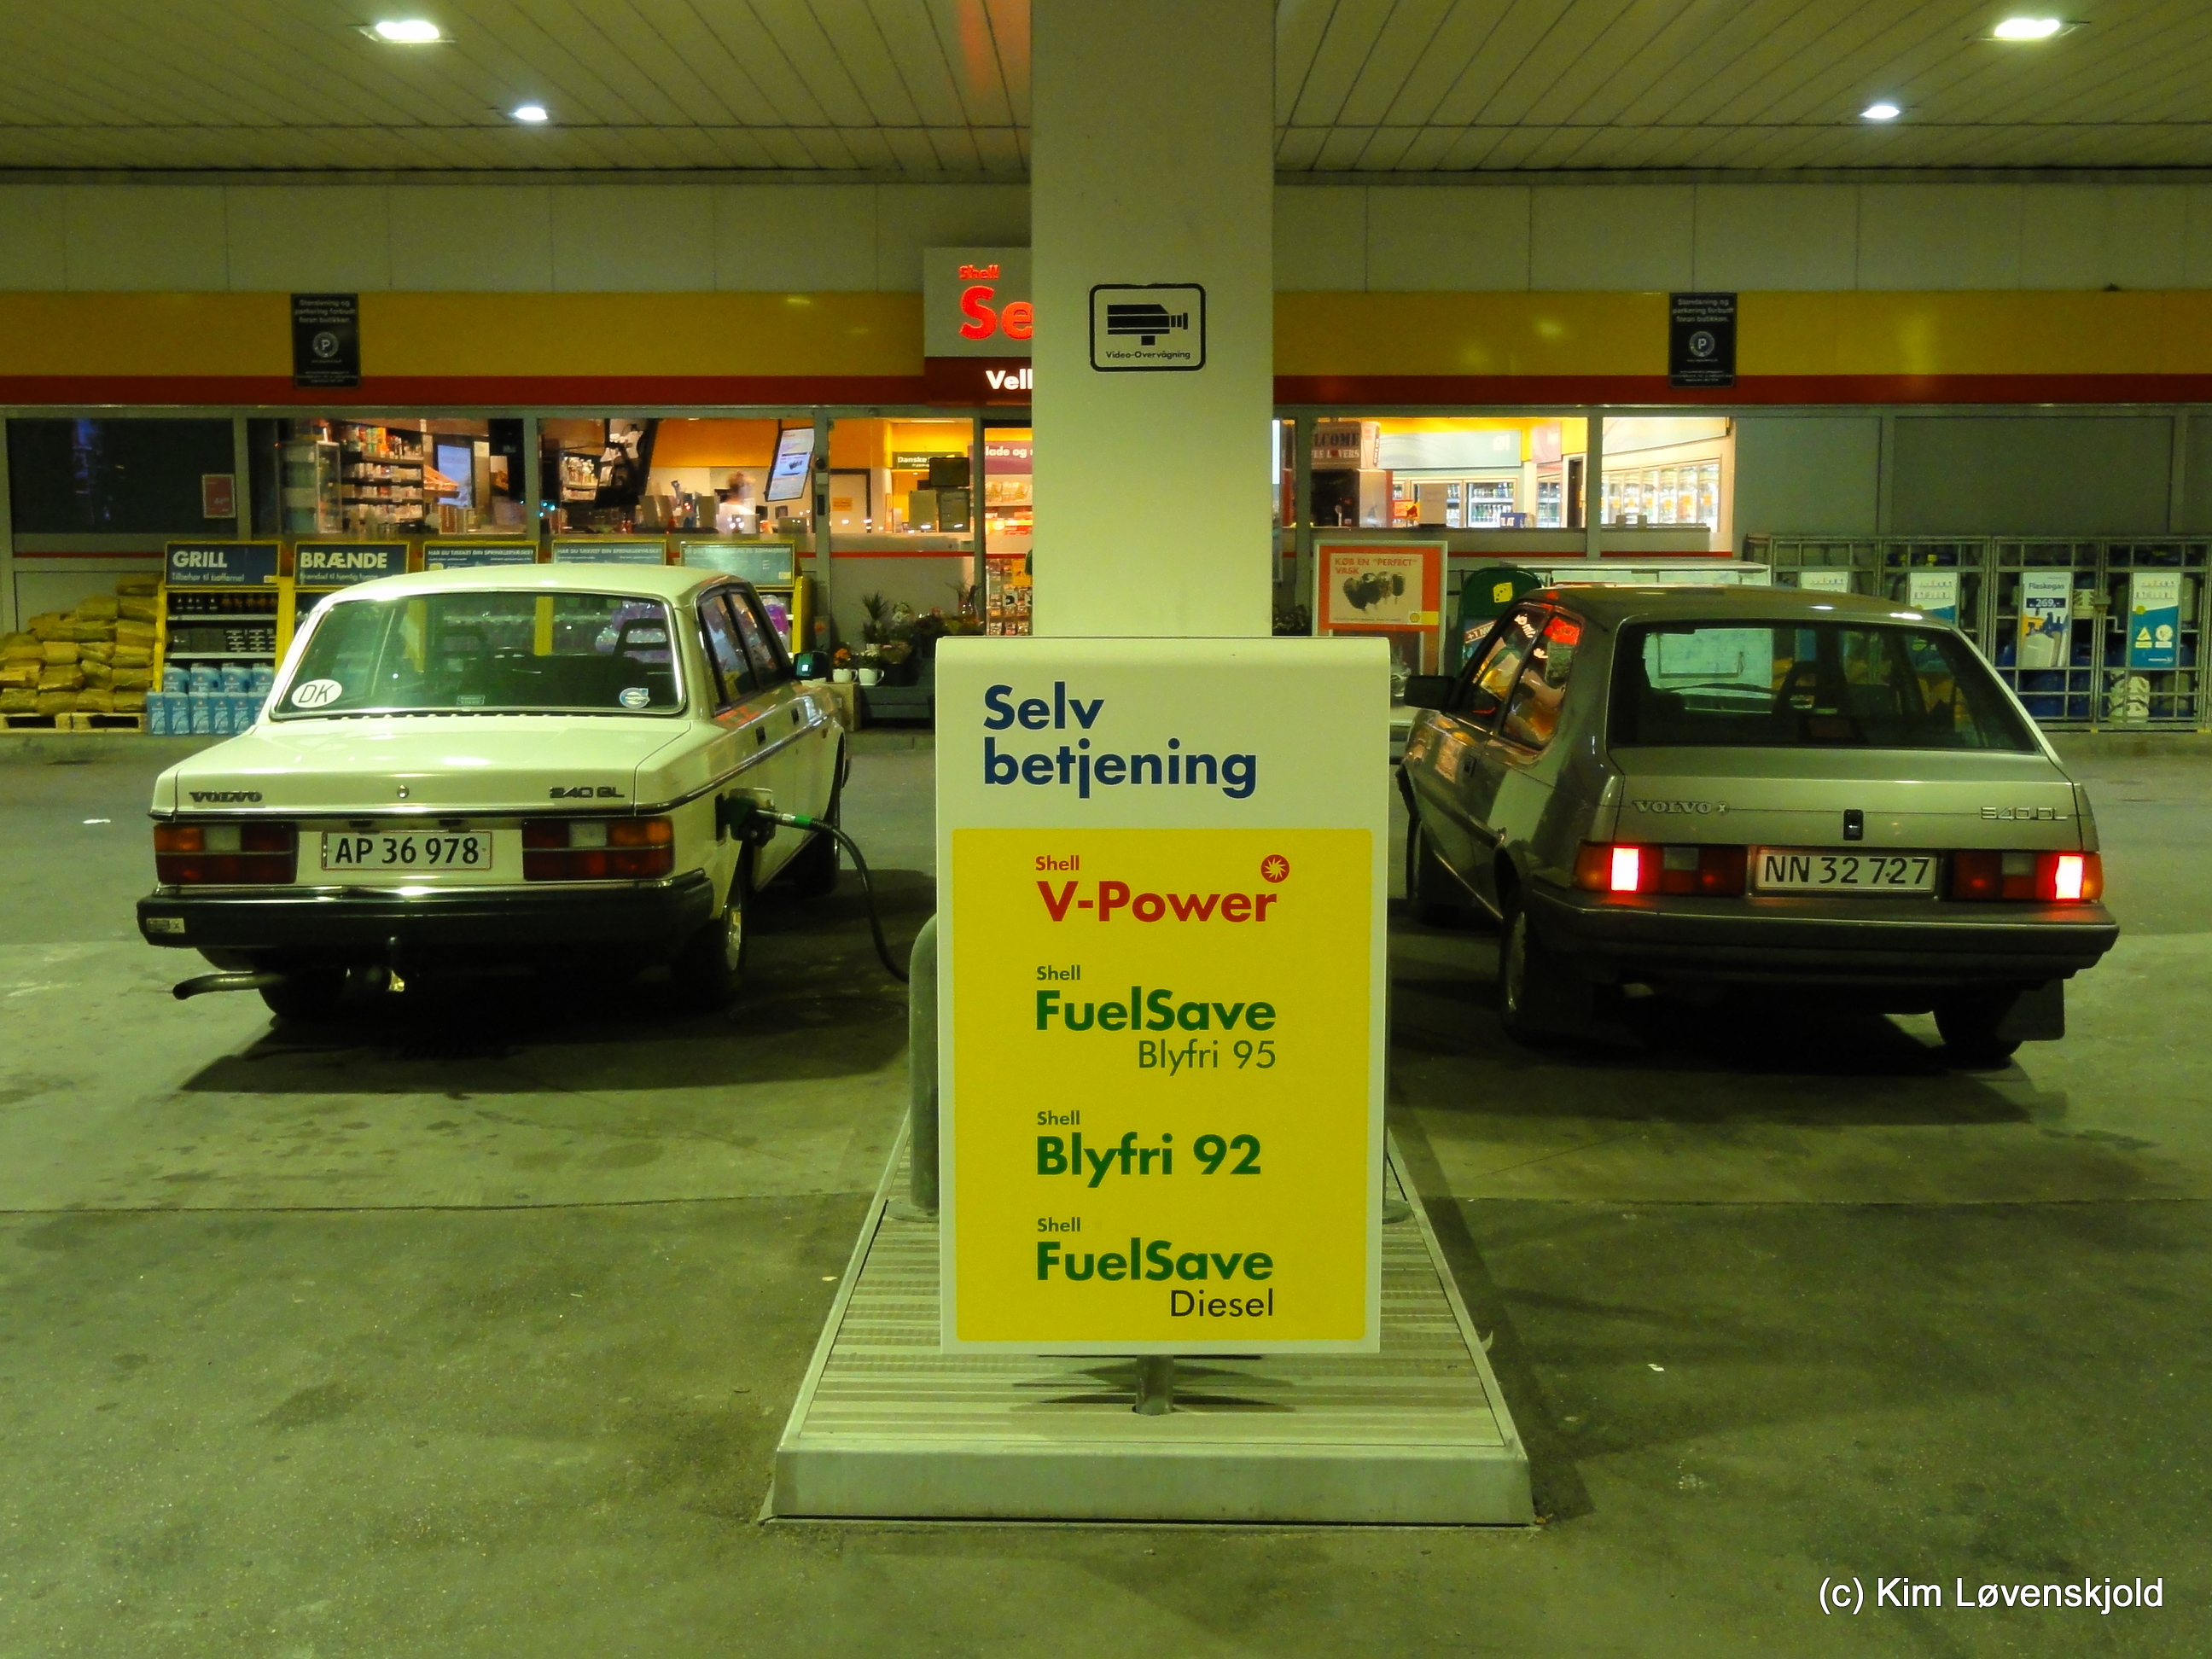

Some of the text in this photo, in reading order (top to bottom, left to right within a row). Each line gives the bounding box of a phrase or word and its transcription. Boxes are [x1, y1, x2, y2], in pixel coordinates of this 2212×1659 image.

[958, 265, 999, 279] Shell
[959, 285, 1033, 340] Se
[1106, 351, 1190, 359] Video-Overvågning
[1012, 449, 1027, 458] og
[172, 550, 227, 568] GRILL
[300, 552, 387, 568] BRÆNDE
[299, 684, 335, 703] DK
[983, 681, 1104, 731] Selv
[983, 736, 1257, 800] betjening
[189, 791, 263, 802] VOLVO
[549, 787, 593, 799] 240
[1633, 800, 1711, 814] VOLVO
[335, 836, 480, 864] AP 36 978
[1035, 855, 1080, 871] Shell
[1765, 856, 1930, 885] NN 32 727
[1037, 881, 1278, 923] V-Power
[1036, 965, 1081, 981] Shell
[1036, 986, 1276, 1031] FuelSave
[1138, 1039, 1276, 1076] Blyfri 95
[1037, 1110, 1080, 1126] Shell
[1037, 1132, 1261, 1188] Blyfri 92
[1037, 1217, 1081, 1232] Shell
[1037, 1237, 1273, 1281] FuelSave
[1170, 1289, 1274, 1317] Diesel
